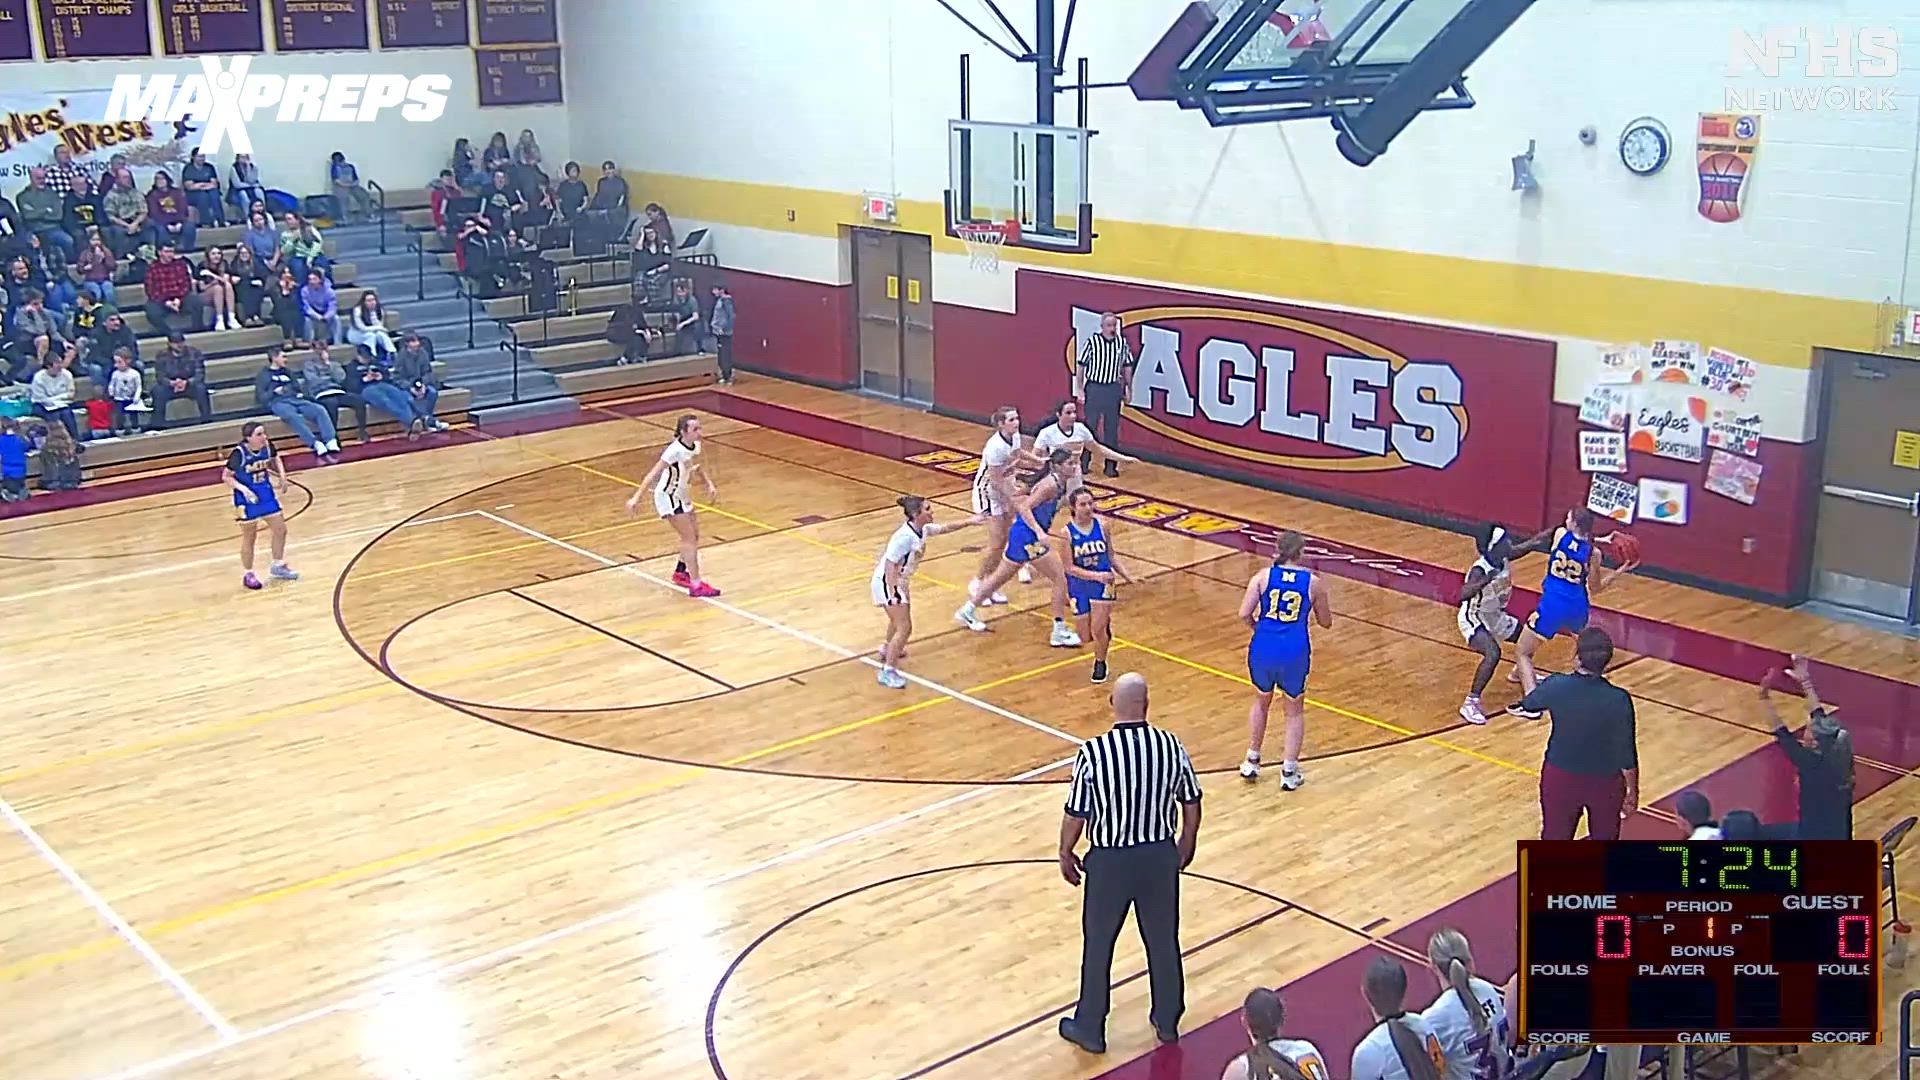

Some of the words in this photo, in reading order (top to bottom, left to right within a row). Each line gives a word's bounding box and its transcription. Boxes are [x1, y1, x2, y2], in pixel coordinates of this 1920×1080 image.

[55, 6, 91, 15] DISTRICT
[97, 6, 132, 15] CHAMPS
[1701, 375, 1723, 392] #30
[1638, 406, 1690, 438] Eagles
[1073, 540, 1107, 559] MIO
[1550, 549, 1583, 584] 22
[1265, 588, 1302, 622] 13
